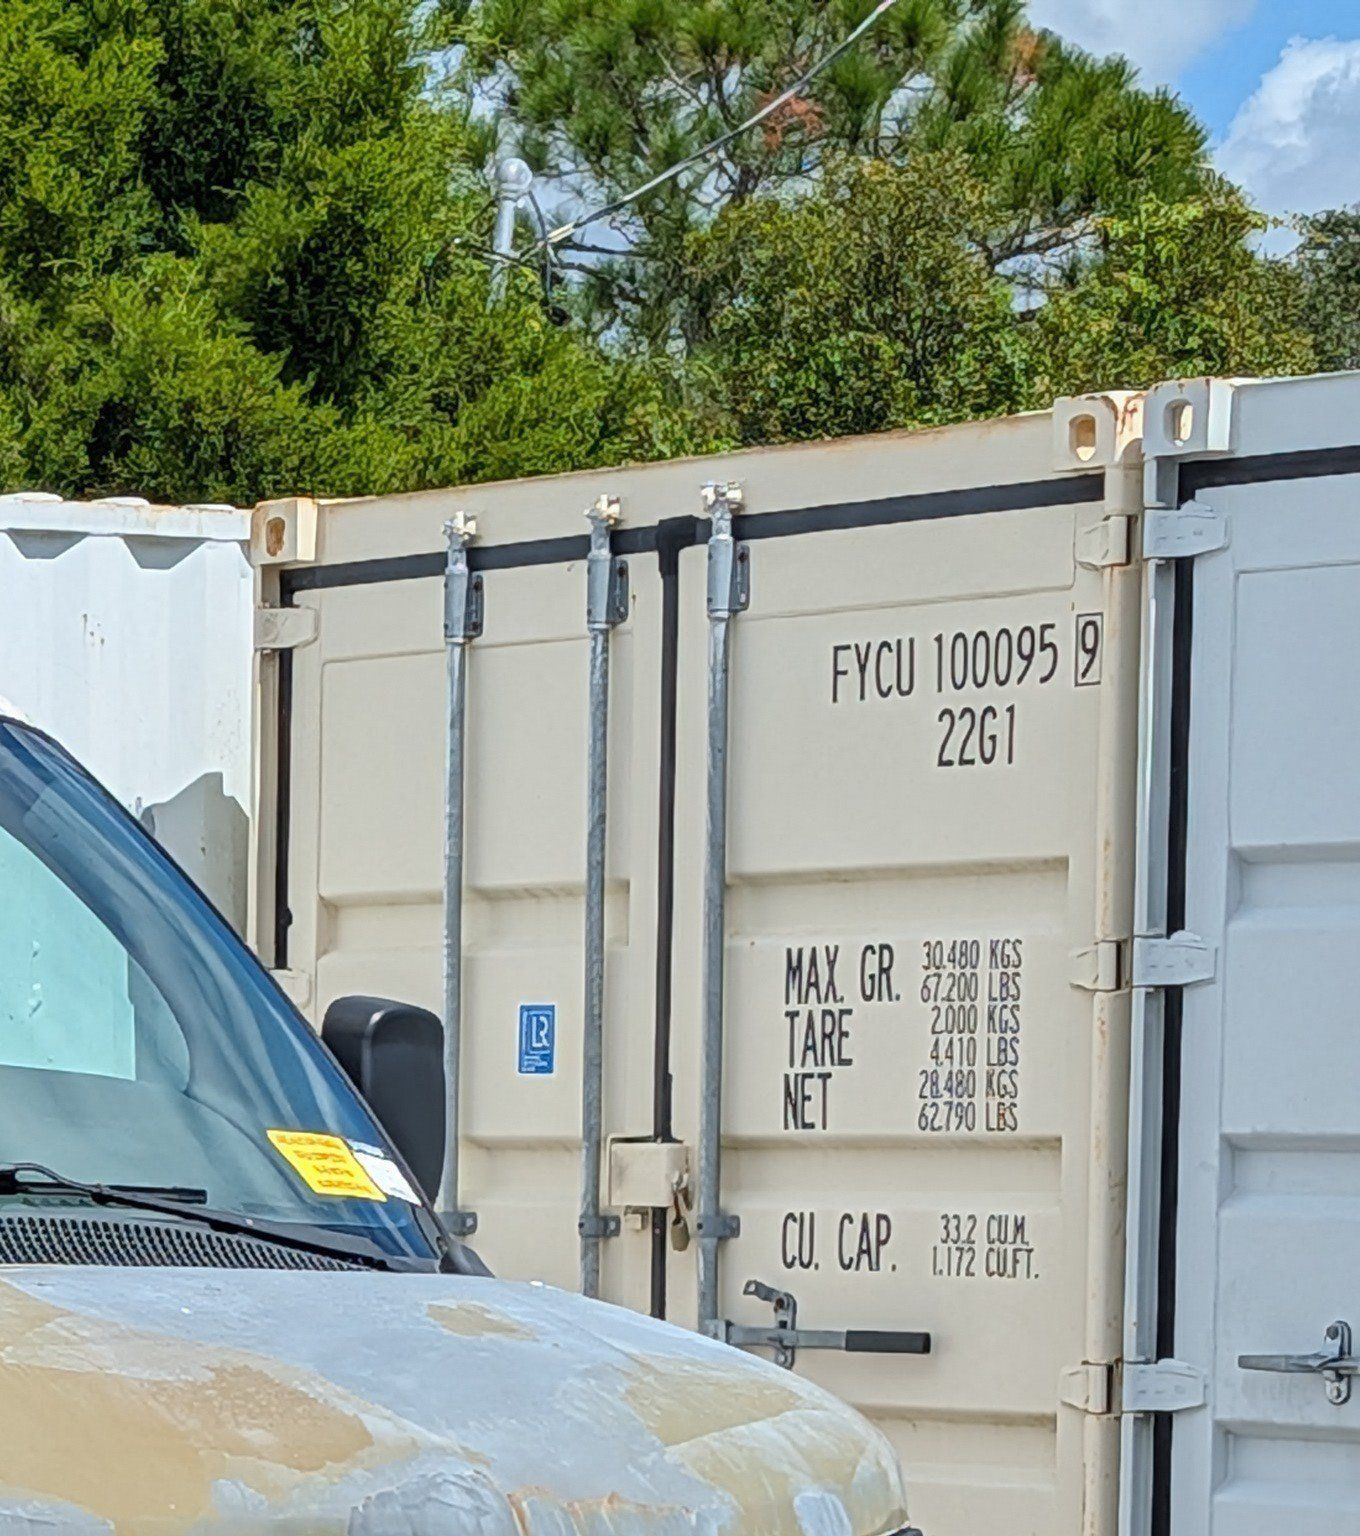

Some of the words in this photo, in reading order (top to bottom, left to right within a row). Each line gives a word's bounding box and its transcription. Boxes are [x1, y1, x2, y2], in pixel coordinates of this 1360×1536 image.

[832, 637, 915, 703] FYCU
[934, 623, 1059, 693] 100095
[1079, 617, 1101, 683] 9
[937, 703, 1016, 767] 22G1
[922, 939, 980, 970] 30.480
[988, 938, 1023, 970] KGS
[785, 944, 845, 1005] MAX.
[860, 943, 901, 1003] GR.
[920, 972, 979, 1003] 67.200
[987, 971, 1022, 1002] LBS
[987, 1004, 1021, 1035] KGS
[784, 1008, 853, 1068] TARE
[986, 1036, 1020, 1066] LBS
[918, 1069, 976, 1100] 28.480
[985, 1069, 1018, 1100] KGS
[783, 1072, 832, 1130] NET
[985, 1101, 1018, 1132] LBS
[781, 1211, 819, 1271] CU.
[838, 1211, 897, 1272] CAP.
[940, 1213, 978, 1244] 33.2
[932, 1246, 976, 1277] 1.172
